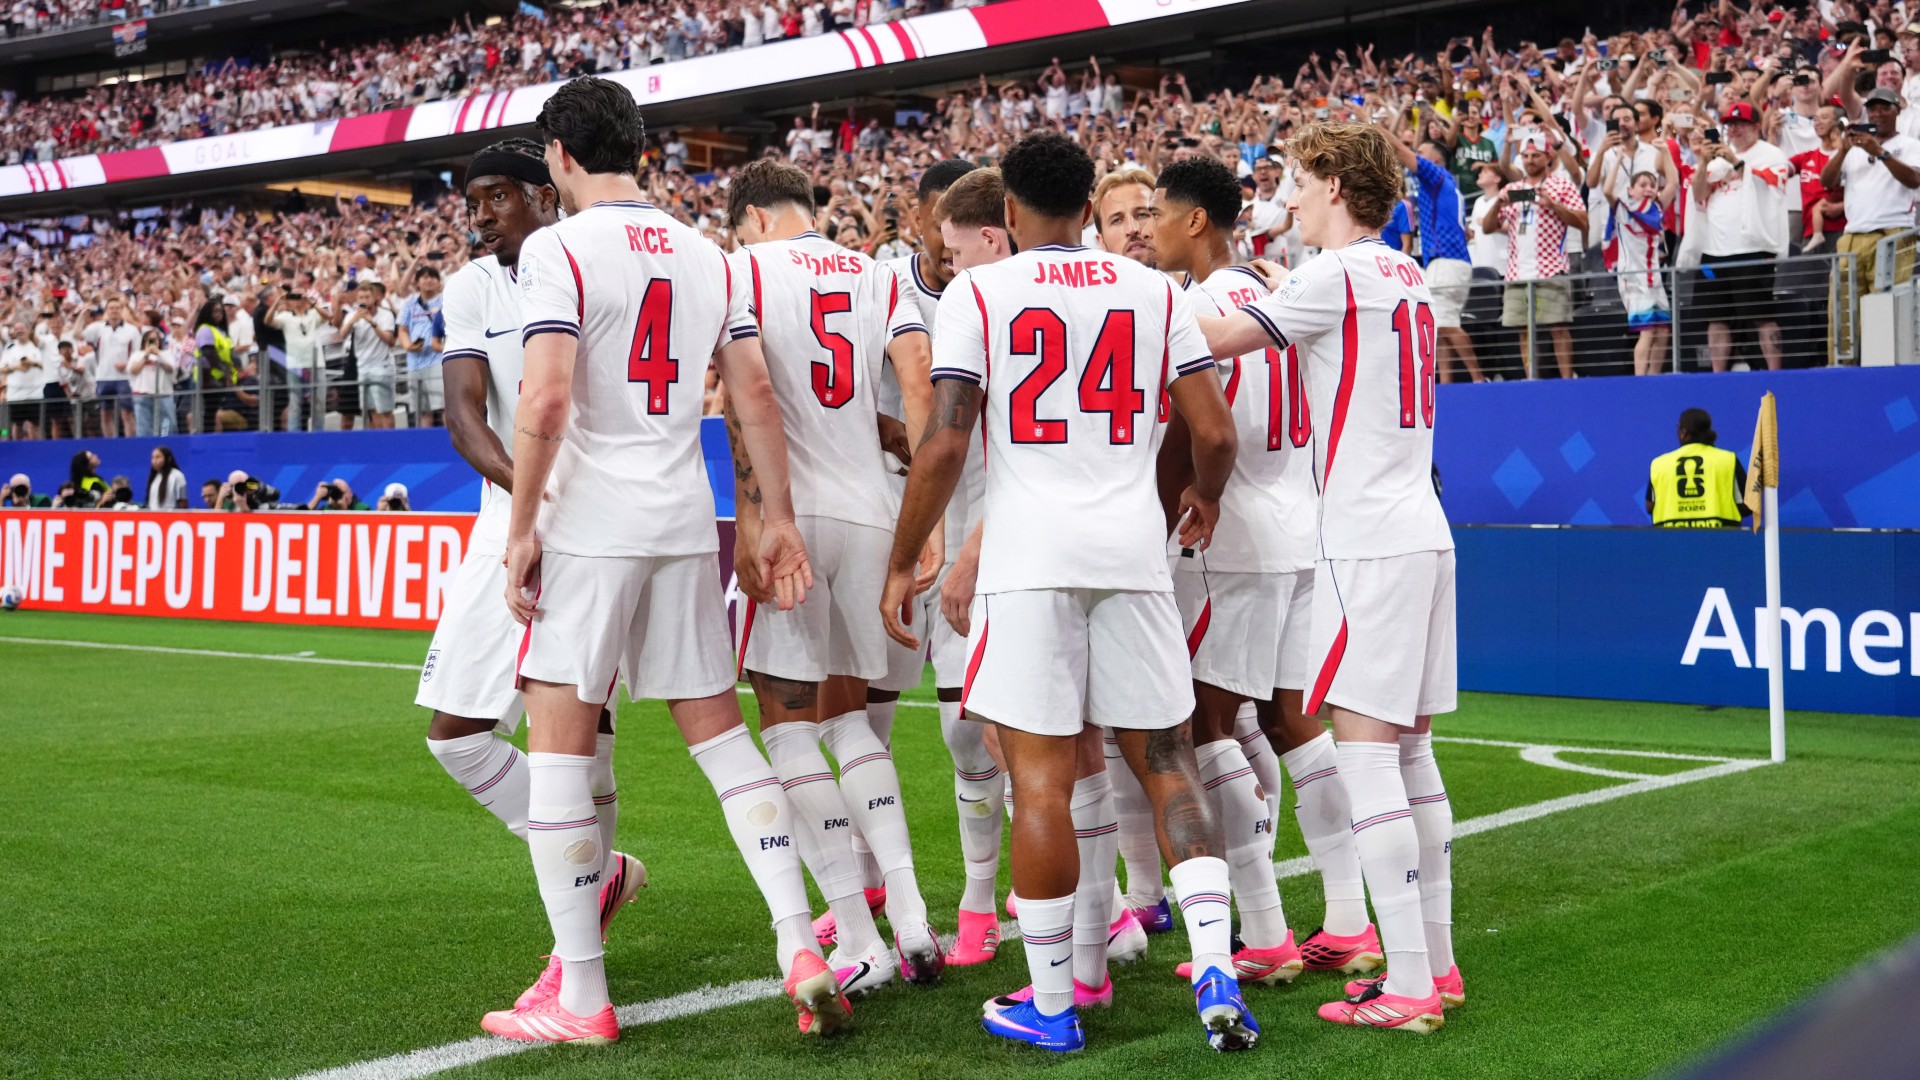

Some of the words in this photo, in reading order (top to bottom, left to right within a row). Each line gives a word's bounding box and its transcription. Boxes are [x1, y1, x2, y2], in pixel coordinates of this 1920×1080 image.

[195, 140, 252, 164] GOAL
[624, 224, 674, 254] RICE
[1033, 260, 1118, 288] JAMES
[628, 278, 679, 415] 4
[810, 287, 854, 409] 5
[1009, 307, 1145, 445] 24
[1392, 299, 1435, 429] 18
[1265, 343, 1312, 452] 10
[0, 518, 66, 602] ME
[81, 520, 225, 609] DEPOT
[867, 795, 895, 811] ENG
[824, 817, 849, 831] ENG
[760, 835, 790, 851] ENG
[574, 870, 600, 887] ENG
[1406, 869, 1419, 883] EN
